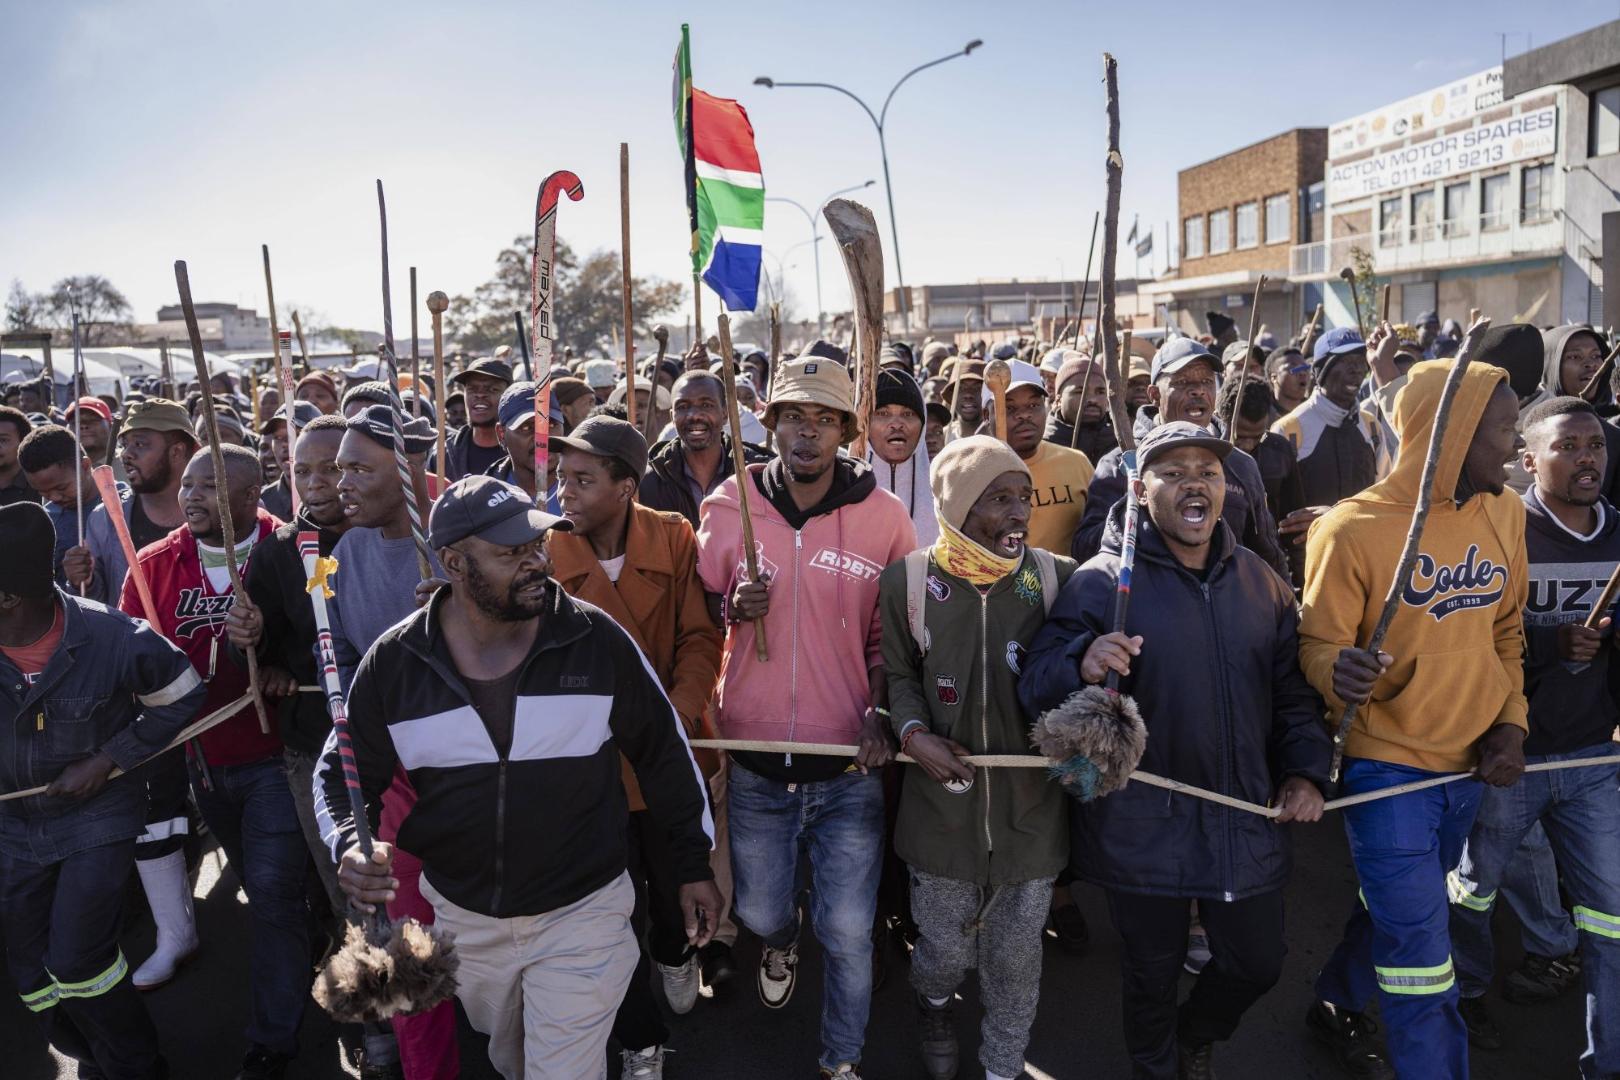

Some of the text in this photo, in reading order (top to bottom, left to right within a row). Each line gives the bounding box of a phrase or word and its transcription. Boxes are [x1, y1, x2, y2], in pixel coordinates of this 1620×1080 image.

[1333, 157, 1386, 181] ACTON
[1390, 137, 1457, 166] MOTOR
[1463, 111, 1553, 147] SPARES
[1391, 167, 1417, 185] 011
[1422, 158, 1451, 176] 421
[1458, 144, 1503, 169] 9213
[1401, 544, 1495, 608] Code
